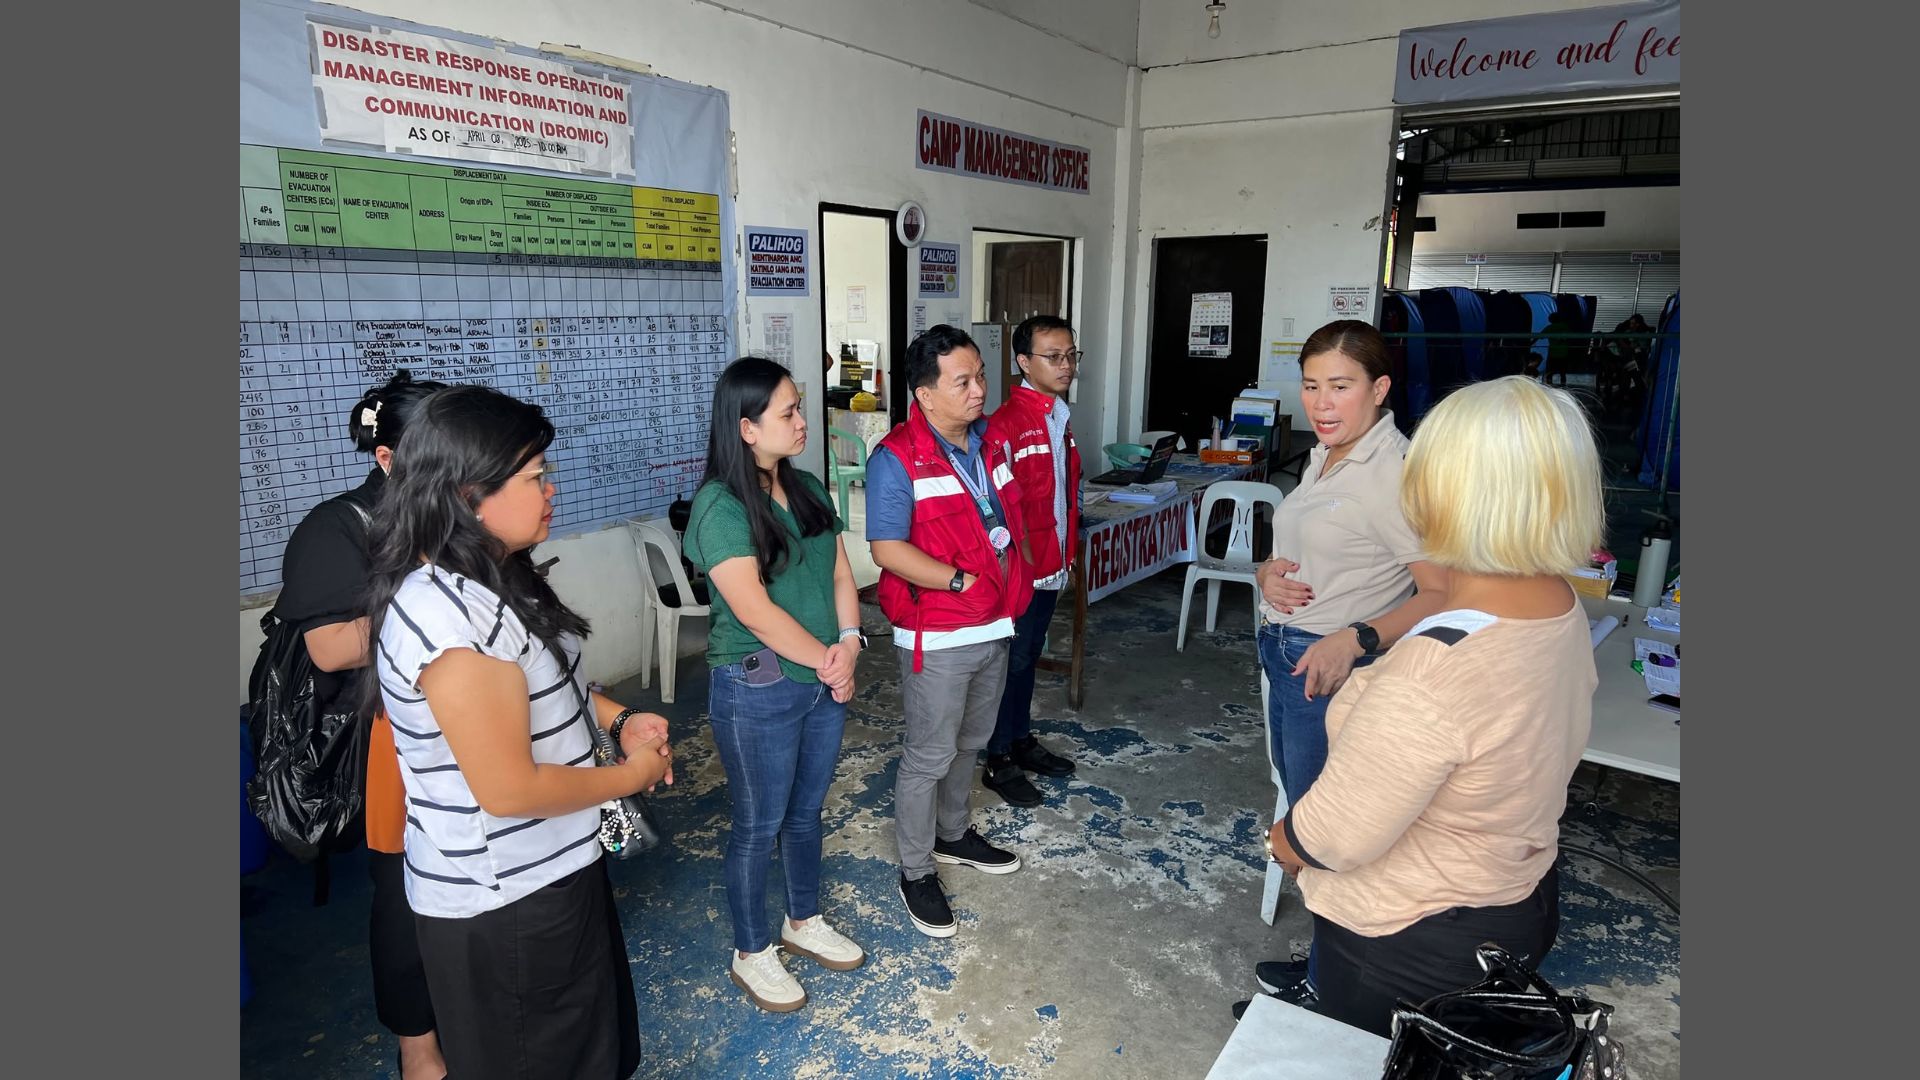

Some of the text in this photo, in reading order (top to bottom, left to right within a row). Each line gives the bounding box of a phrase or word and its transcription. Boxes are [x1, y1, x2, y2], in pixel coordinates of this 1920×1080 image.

[1410, 20, 1680, 80] Welcome and fee
[323, 30, 624, 101] DISASTER RESPONSE OPERATION
[324, 60, 627, 125] MANAGEMENT INFORMATION AND
[365, 96, 609, 149] COMMUNICATION (DROMIC)
[408, 127, 427, 141] AS
[467, 130, 486, 143] APRIL
[919, 116, 1088, 190] CAMP MANAGEMENT OFFICE
[290, 170, 318, 180] NUMBER
[453, 169, 507, 181] DISPLACEMENT DATA
[288, 183, 331, 193] EVACUATION
[546, 190, 565, 198] NUMBER
[573, 193, 597, 201] DISPLACED
[286, 195, 336, 207] CENTERS (ECs)
[343, 198, 361, 207] NAME
[372, 200, 409, 210] EVACUATION
[460, 197, 476, 206] Origin
[260, 206, 273, 214] 4Ps
[419, 210, 445, 218] ADDRESS
[365, 211, 389, 220] CENTER
[253, 218, 281, 227] Families
[294, 224, 310, 233] CUM
[321, 225, 337, 234] NOW
[490, 229, 503, 238] Brgy
[456, 233, 468, 243] Brgy
[528, 236, 539, 244] NOW
[489, 240, 504, 248] Count
[751, 235, 802, 252] PALIHOG
[260, 245, 282, 256] 156
[328, 248, 336, 257] 4
[922, 249, 955, 262] PALIHOG
[752, 253, 789, 262] MENTINARON
[751, 265, 774, 273] KATINLO
[790, 266, 805, 274] ATON
[750, 277, 805, 287] EVACUATION CENTER
[247, 408, 265, 417] 100
[286, 404, 299, 413] 30
[260, 503, 281, 515] 509
[1088, 500, 1189, 592] REGISTRATION
